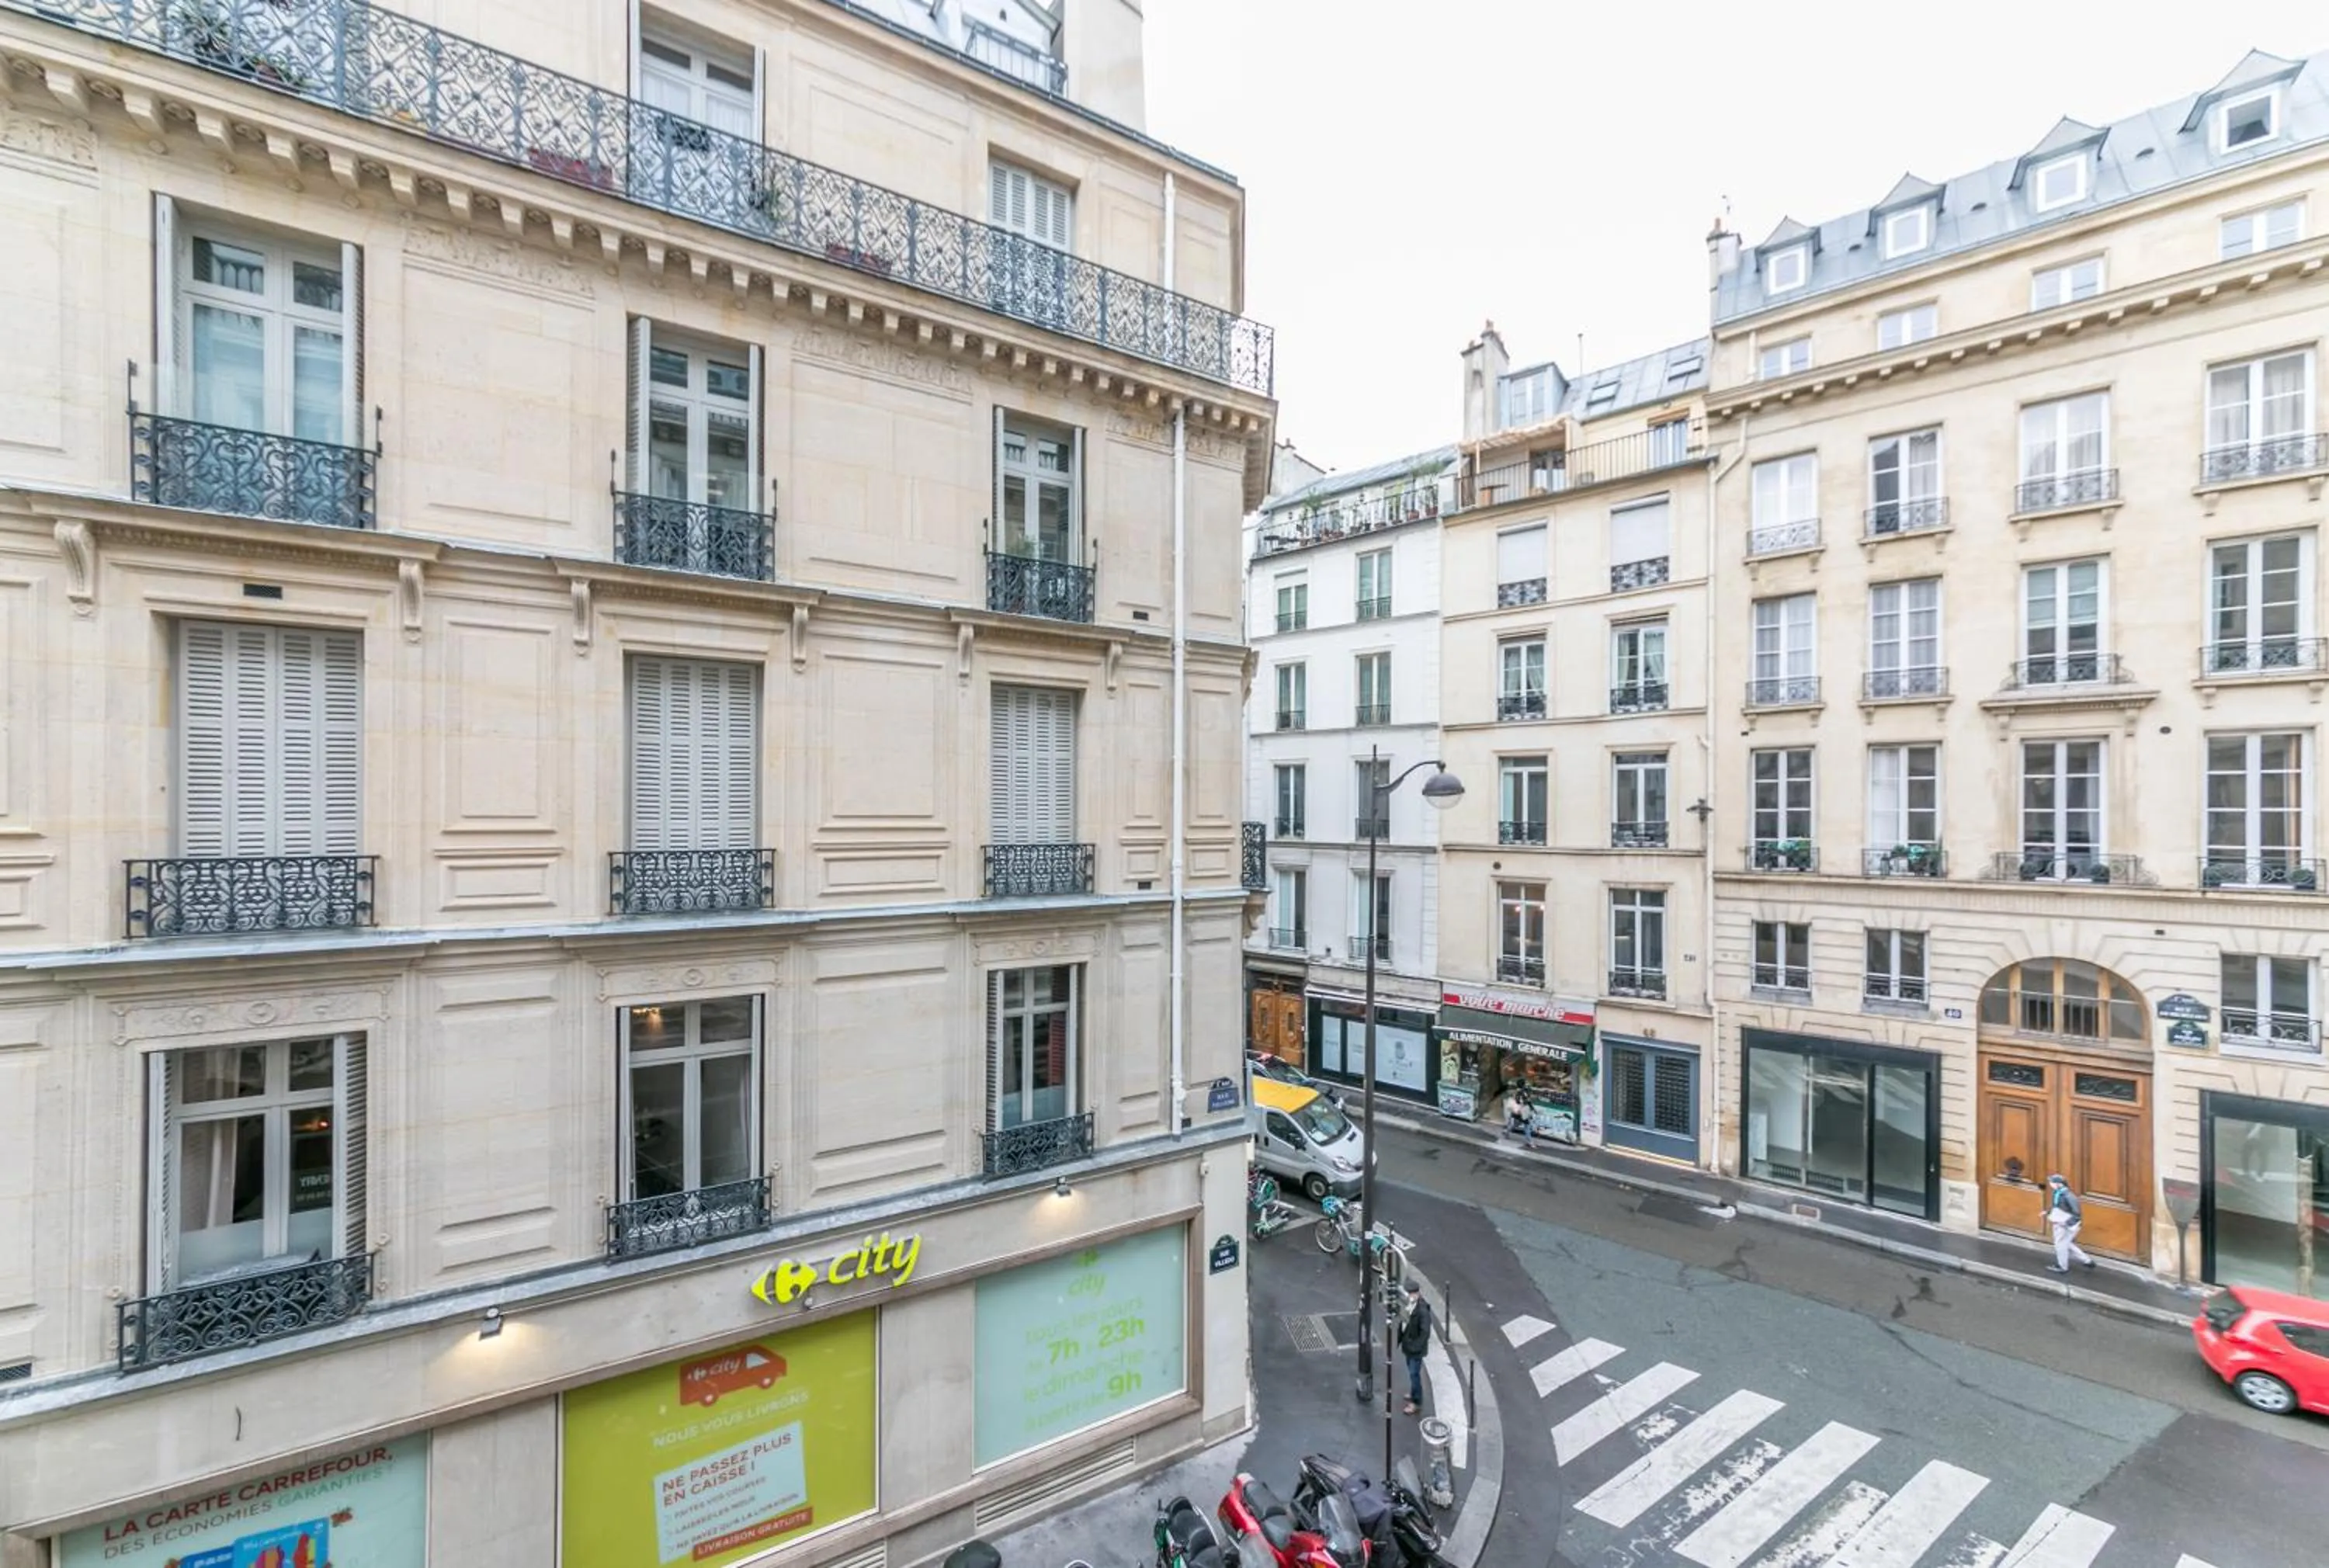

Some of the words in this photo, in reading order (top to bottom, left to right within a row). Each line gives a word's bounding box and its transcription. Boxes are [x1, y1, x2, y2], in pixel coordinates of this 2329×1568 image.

[1449, 1032, 1513, 1049] ALIMENTATION
[828, 1232, 922, 1288] city
[1068, 1273, 1105, 1296] city
[1048, 1338, 1079, 1365] 7h
[1099, 1317, 1144, 1348] 23h
[710, 1358, 741, 1375] city
[1109, 1368, 1142, 1399] 9h
[653, 1426, 698, 1448] NOUS
[703, 1413, 743, 1431] VOUS
[662, 1476, 685, 1493] NE
[690, 1449, 749, 1482] PASSEZ
[754, 1433, 792, 1456] PLUS
[664, 1490, 686, 1508] EN
[690, 1466, 745, 1494] CAISSE
[104, 1520, 140, 1542] LA
[146, 1491, 231, 1529] CARTE
[699, 1530, 755, 1554] LIVRAISON
[757, 1513, 807, 1535] GRATUITE
[104, 1538, 145, 1559] DES
